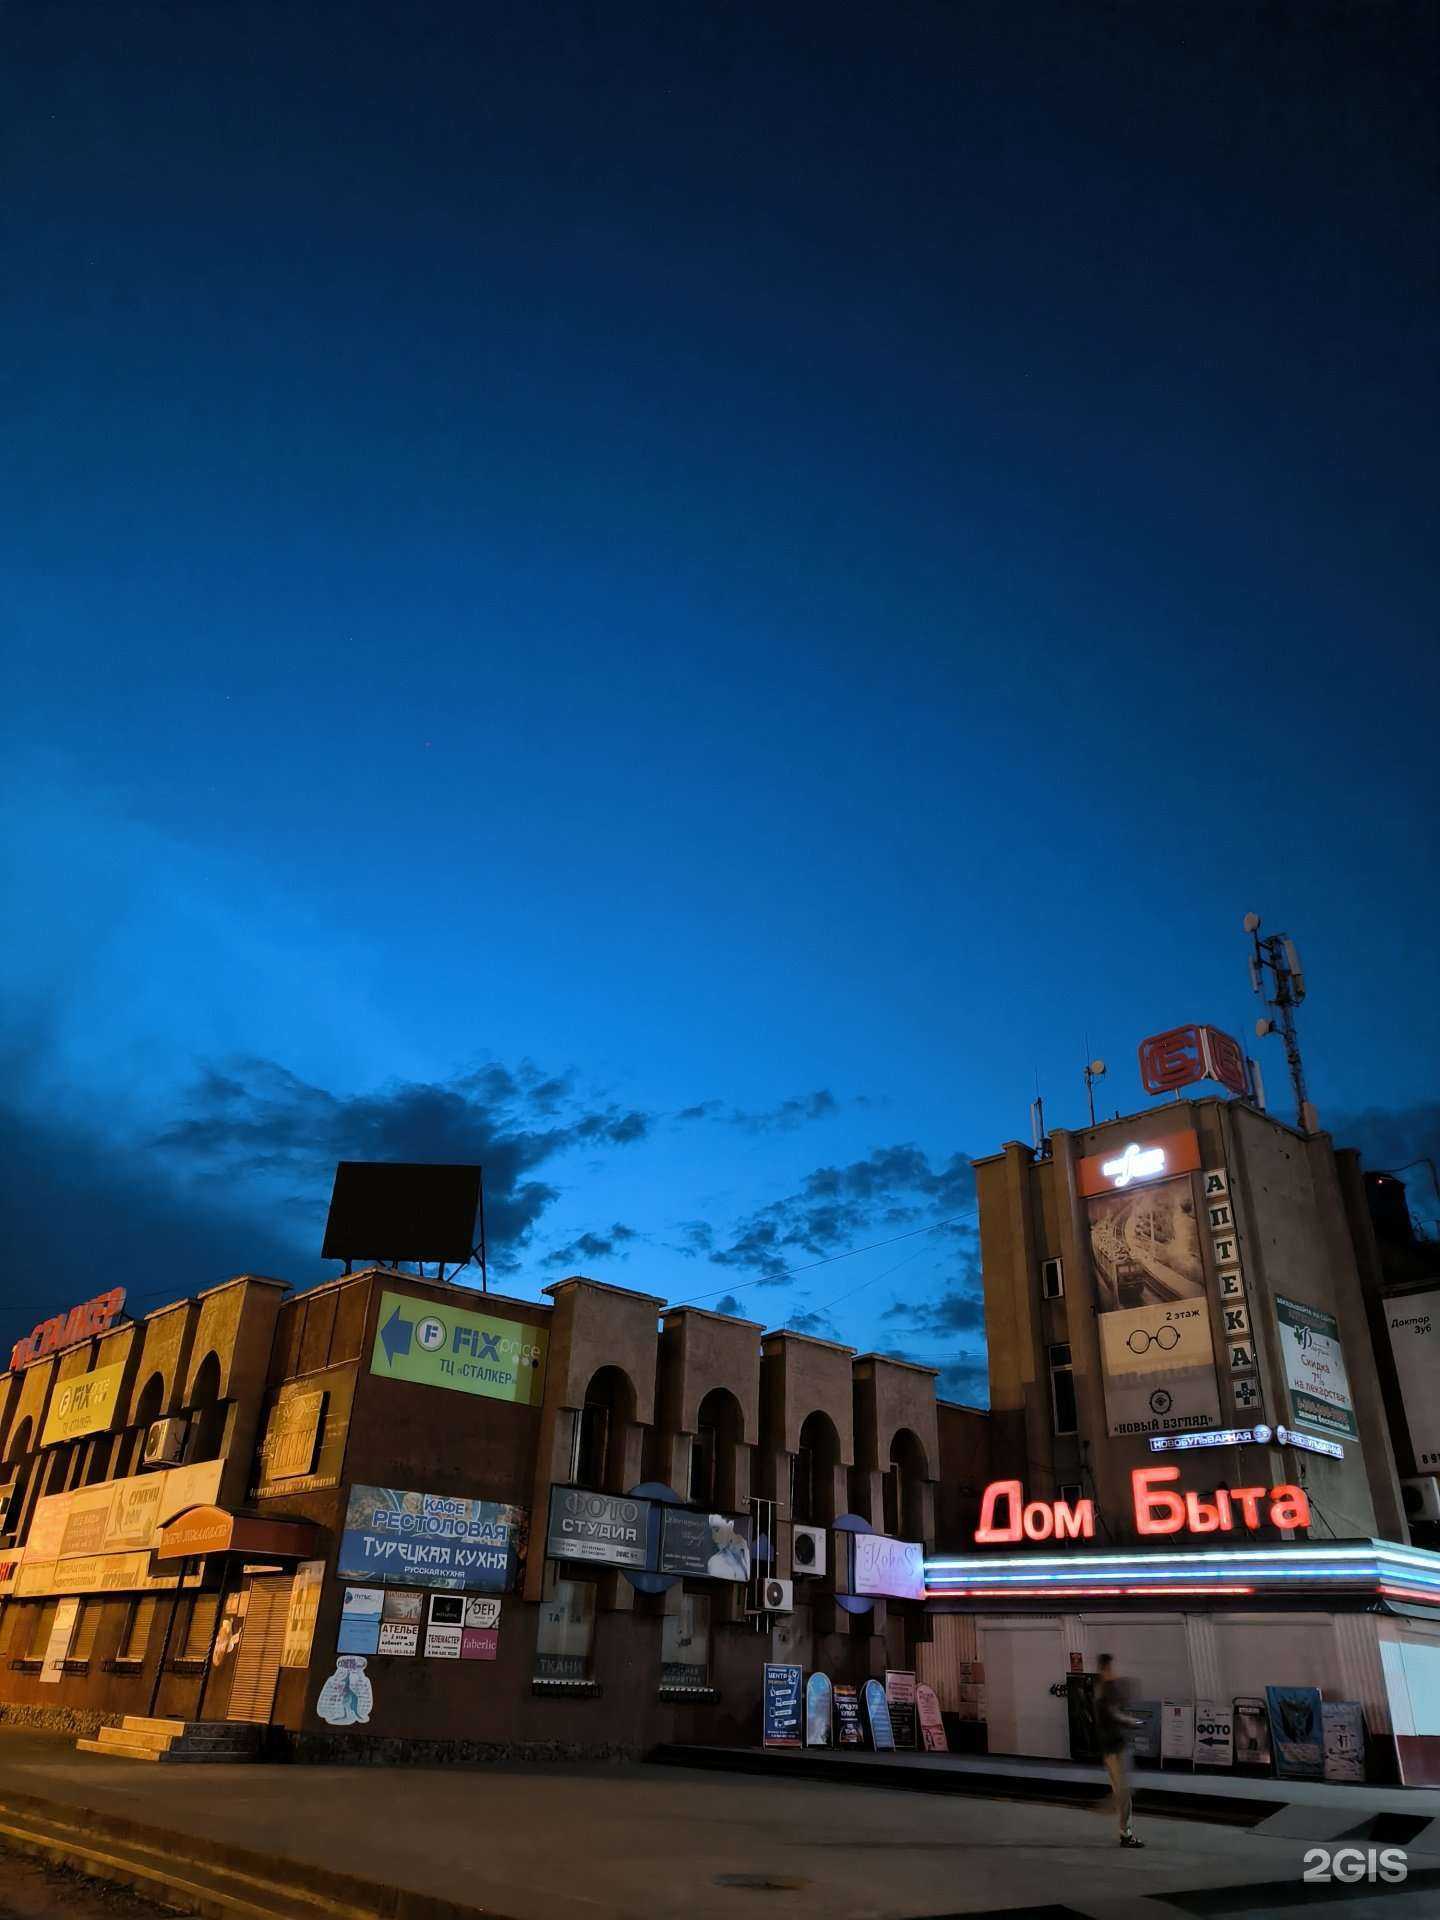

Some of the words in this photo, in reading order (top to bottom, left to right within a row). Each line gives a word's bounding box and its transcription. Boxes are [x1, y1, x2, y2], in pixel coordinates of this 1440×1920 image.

[1206, 1174, 1251, 1367] АПТЕКА
[1165, 1311, 1172, 1321] 2
[1174, 1309, 1200, 1321] этаж
[1391, 1315, 1430, 1329] Доктор
[1414, 1325, 1432, 1336] Зуб
[452, 1326, 502, 1362] FIX
[440, 1359, 454, 1377] ТЦ
[1153, 1430, 1252, 1448] НОВОБУЛЬВАРНАЯ
[423, 1499, 465, 1516] КАФЕ
[565, 1493, 639, 1523] ФОТО
[974, 1480, 1096, 1543] Дом
[1131, 1466, 1312, 1536] Быта
[372, 1509, 508, 1541] РЕСТОЛОВАЯ
[561, 1518, 638, 1542] СТУДИЯ
[363, 1536, 452, 1564] ТУРЕЦКАЯ
[454, 1549, 508, 1570] КУХНЯ
[404, 1566, 440, 1577] РУССКАЯ
[381, 1624, 419, 1636] АТЕЛЬЕ
[463, 1638, 497, 1651] faberlic
